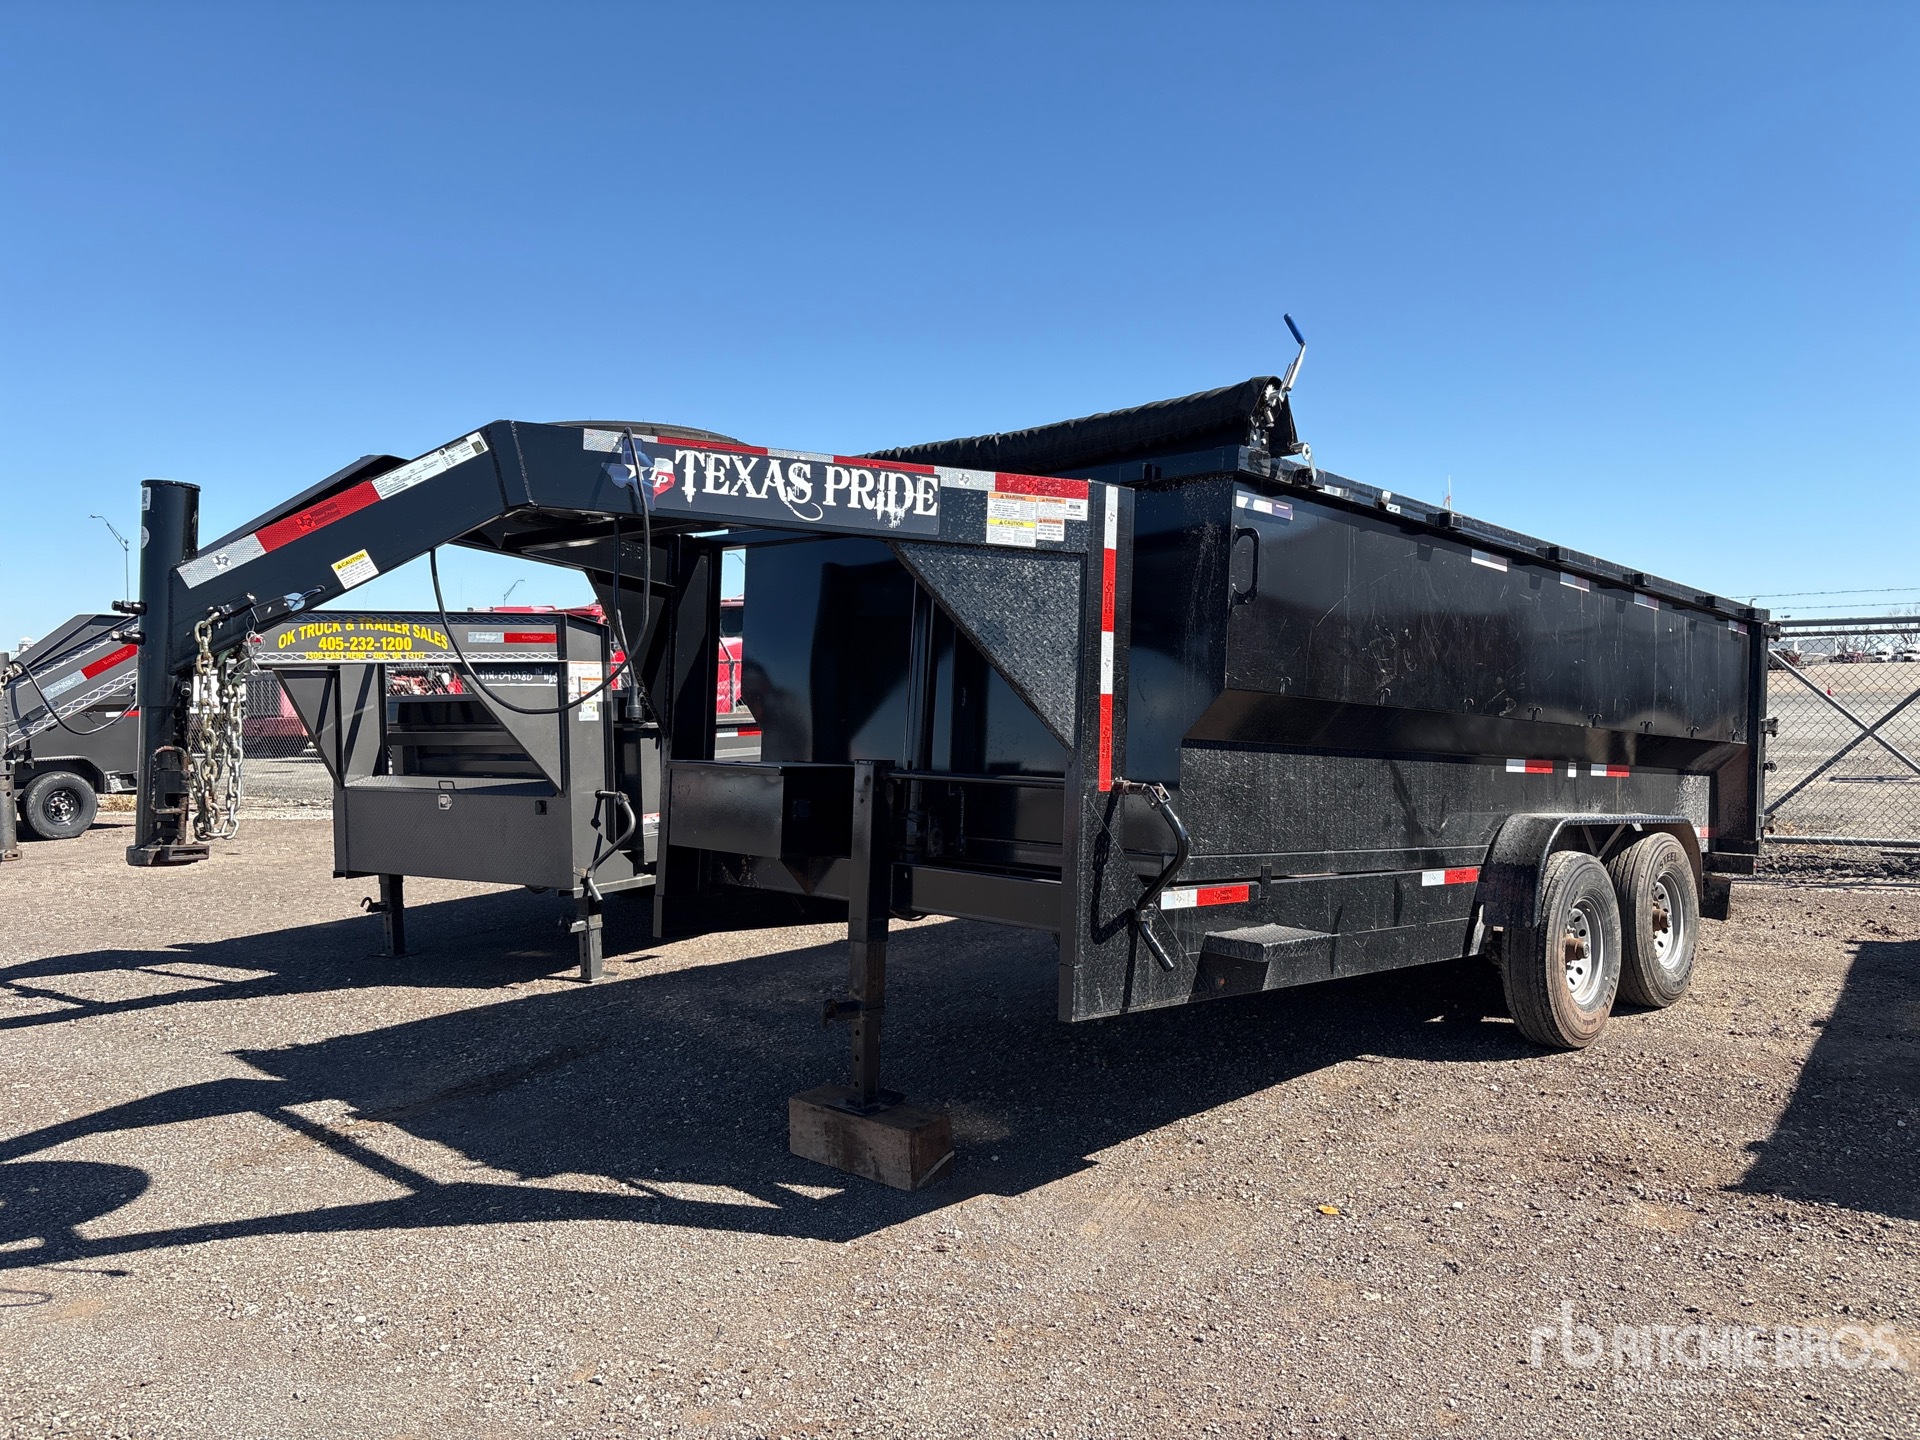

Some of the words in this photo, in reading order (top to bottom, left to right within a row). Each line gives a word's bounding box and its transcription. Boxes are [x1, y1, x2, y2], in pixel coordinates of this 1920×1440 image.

[675, 449, 823, 521] TEXAS
[822, 465, 940, 529] PRIDE
[341, 553, 365, 567] CAUTION
[278, 629, 296, 649] OK
[299, 619, 342, 640] TRUCK
[345, 618, 355, 631] &
[359, 617, 410, 636] TRAILER
[413, 624, 448, 650] SALES
[318, 637, 412, 651] 405-232-1200
[1660, 852, 1677, 870] STEEL
[1602, 962, 1619, 1009] STEEL
